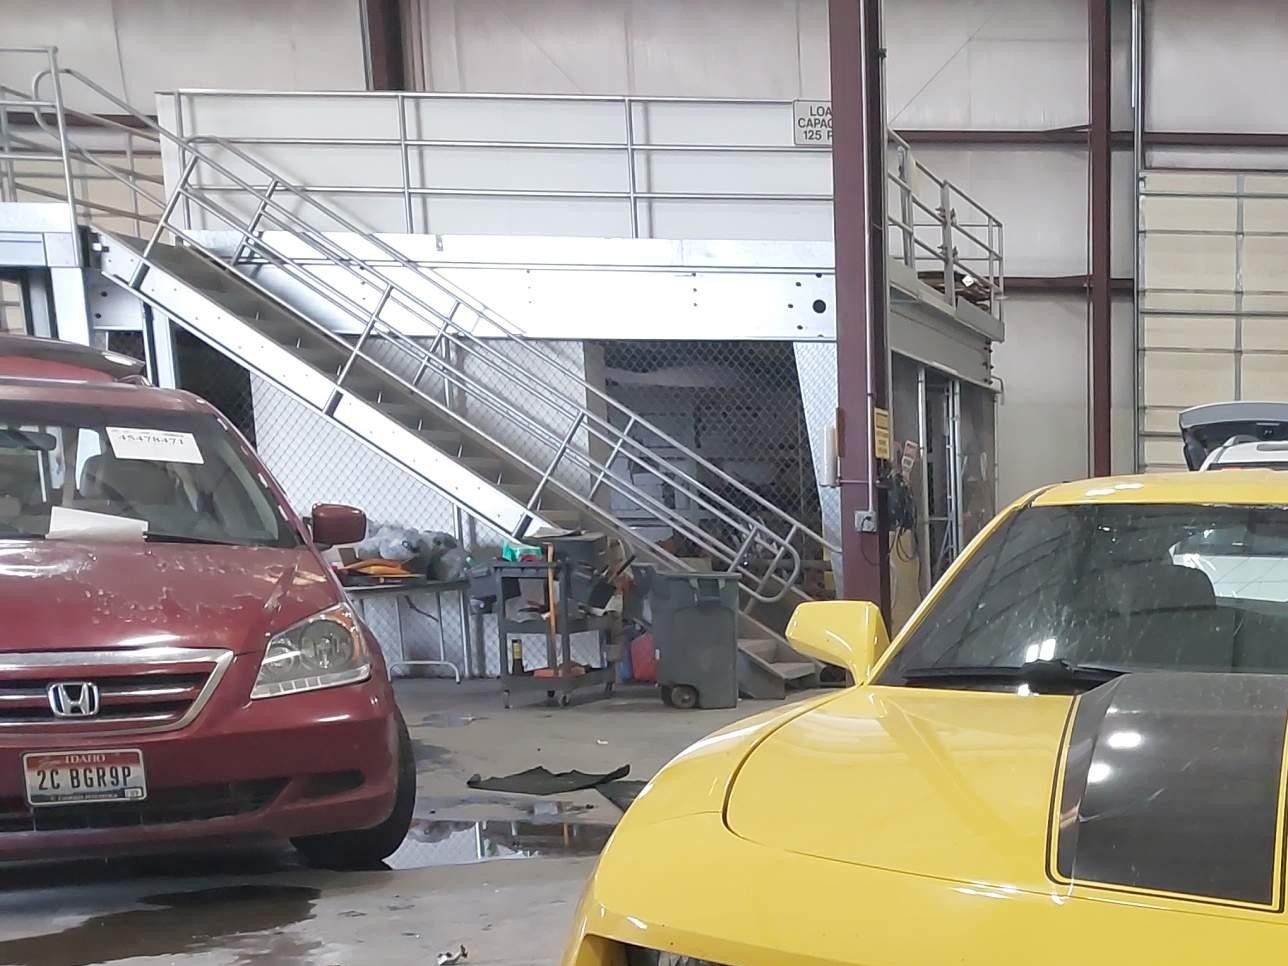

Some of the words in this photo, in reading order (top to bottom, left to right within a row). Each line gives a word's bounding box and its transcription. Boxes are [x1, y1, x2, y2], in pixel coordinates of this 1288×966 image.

[804, 130, 822, 140] 125
[65, 753, 106, 764] IDAHO
[37, 768, 61, 791] 2C
[70, 765, 131, 789] BGR9P
